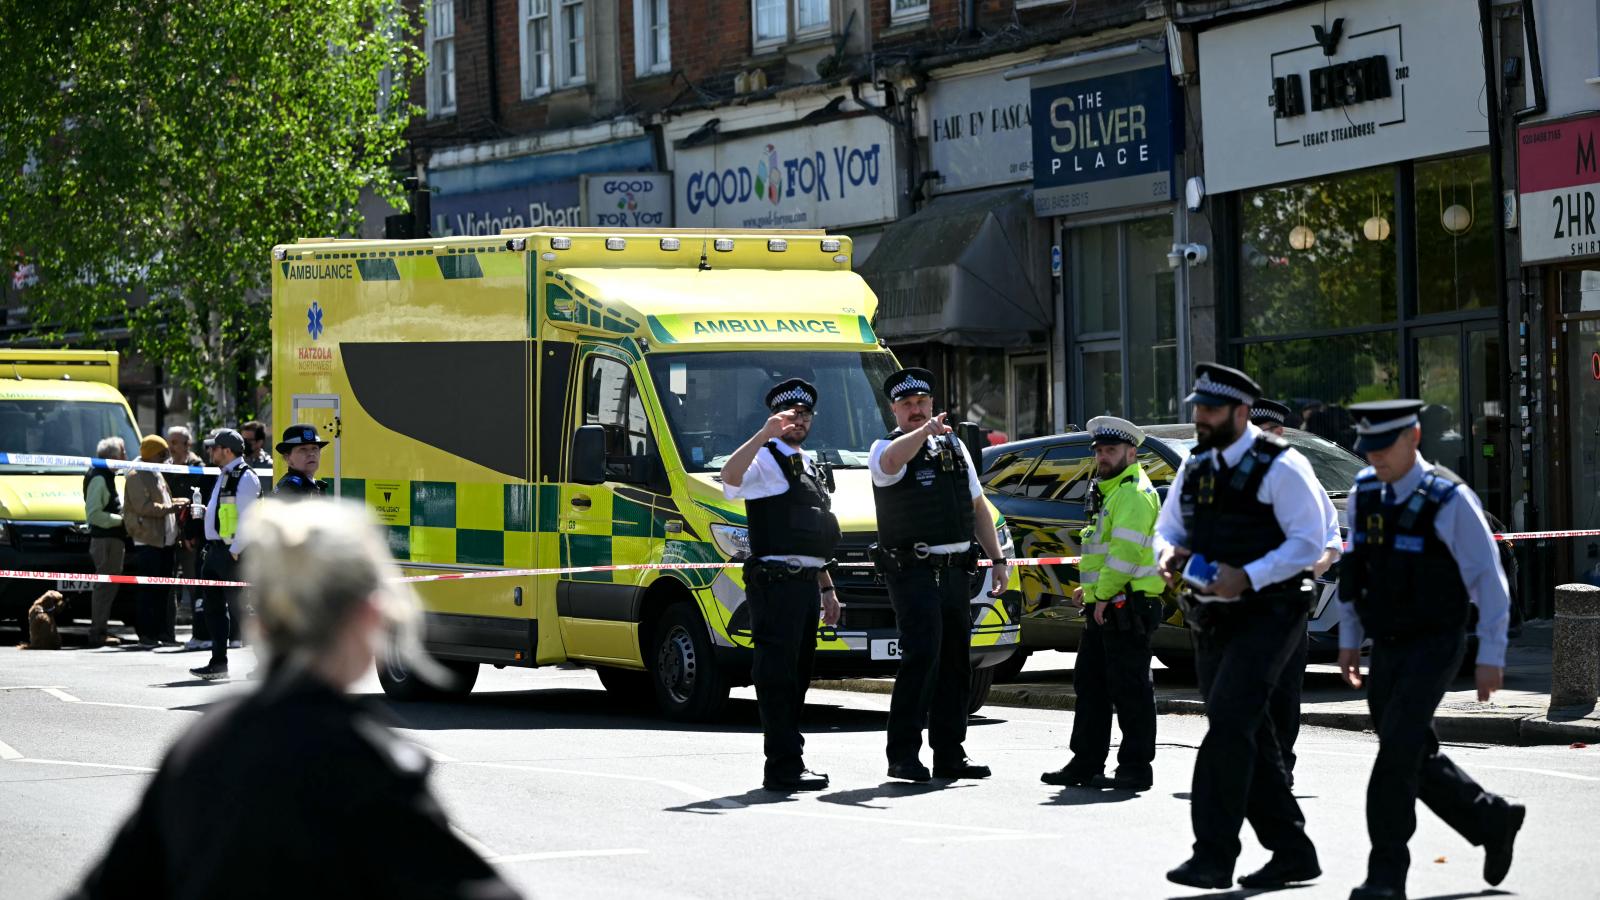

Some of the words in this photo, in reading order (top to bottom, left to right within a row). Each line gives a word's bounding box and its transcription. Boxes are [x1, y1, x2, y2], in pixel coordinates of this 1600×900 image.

[1077, 91, 1102, 108] THE
[933, 116, 963, 142] HAIR
[970, 111, 984, 136] BY
[991, 103, 1032, 132] PASCA
[1051, 96, 1147, 153] SILVER
[1302, 131, 1329, 147] LEGACY
[1331, 121, 1376, 142] STEAKHOUSE
[1051, 145, 1149, 174] PLACE
[604, 180, 654, 194] GOOD
[686, 170, 753, 214] GOOD
[783, 150, 829, 202] FOR
[834, 144, 880, 198] YOU
[456, 206, 524, 236] Victoria
[597, 213, 628, 227] FOR
[632, 212, 663, 226] YOU
[1552, 191, 1596, 239] 2HR
[289, 264, 352, 280] AMBULANCE
[693, 319, 840, 334] AMBULANCE
[298, 347, 332, 360] HATZOLA
[888, 641, 904, 656] G9
